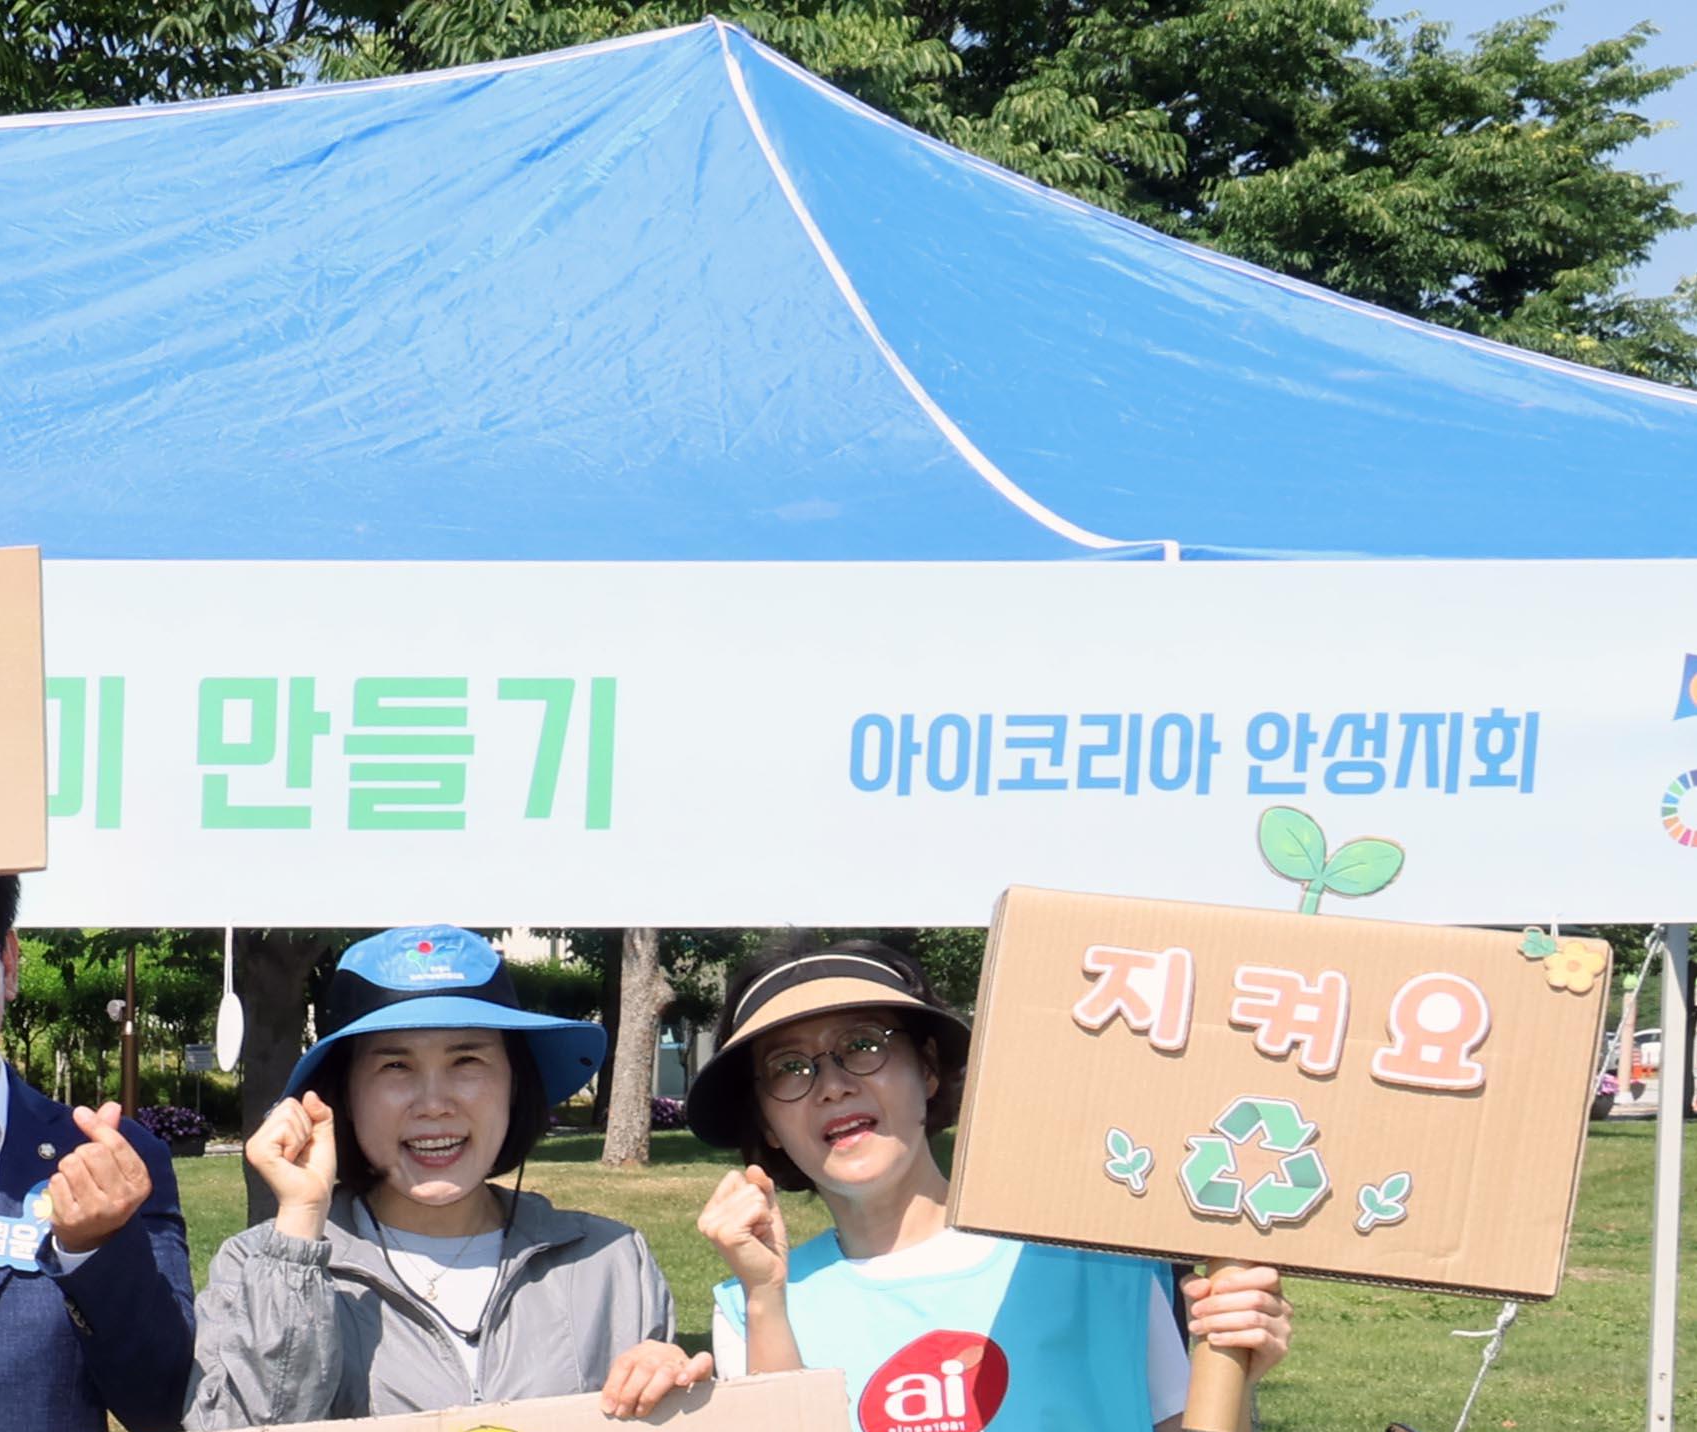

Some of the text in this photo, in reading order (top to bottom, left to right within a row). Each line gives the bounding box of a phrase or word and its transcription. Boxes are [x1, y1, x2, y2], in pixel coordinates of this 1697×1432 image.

[196, 676, 617, 831] 만들기
[848, 707, 1540, 796] 아이코리아 안성지회
[1072, 944, 1492, 1091] 지켜요
[883, 1359, 967, 1422] ai
